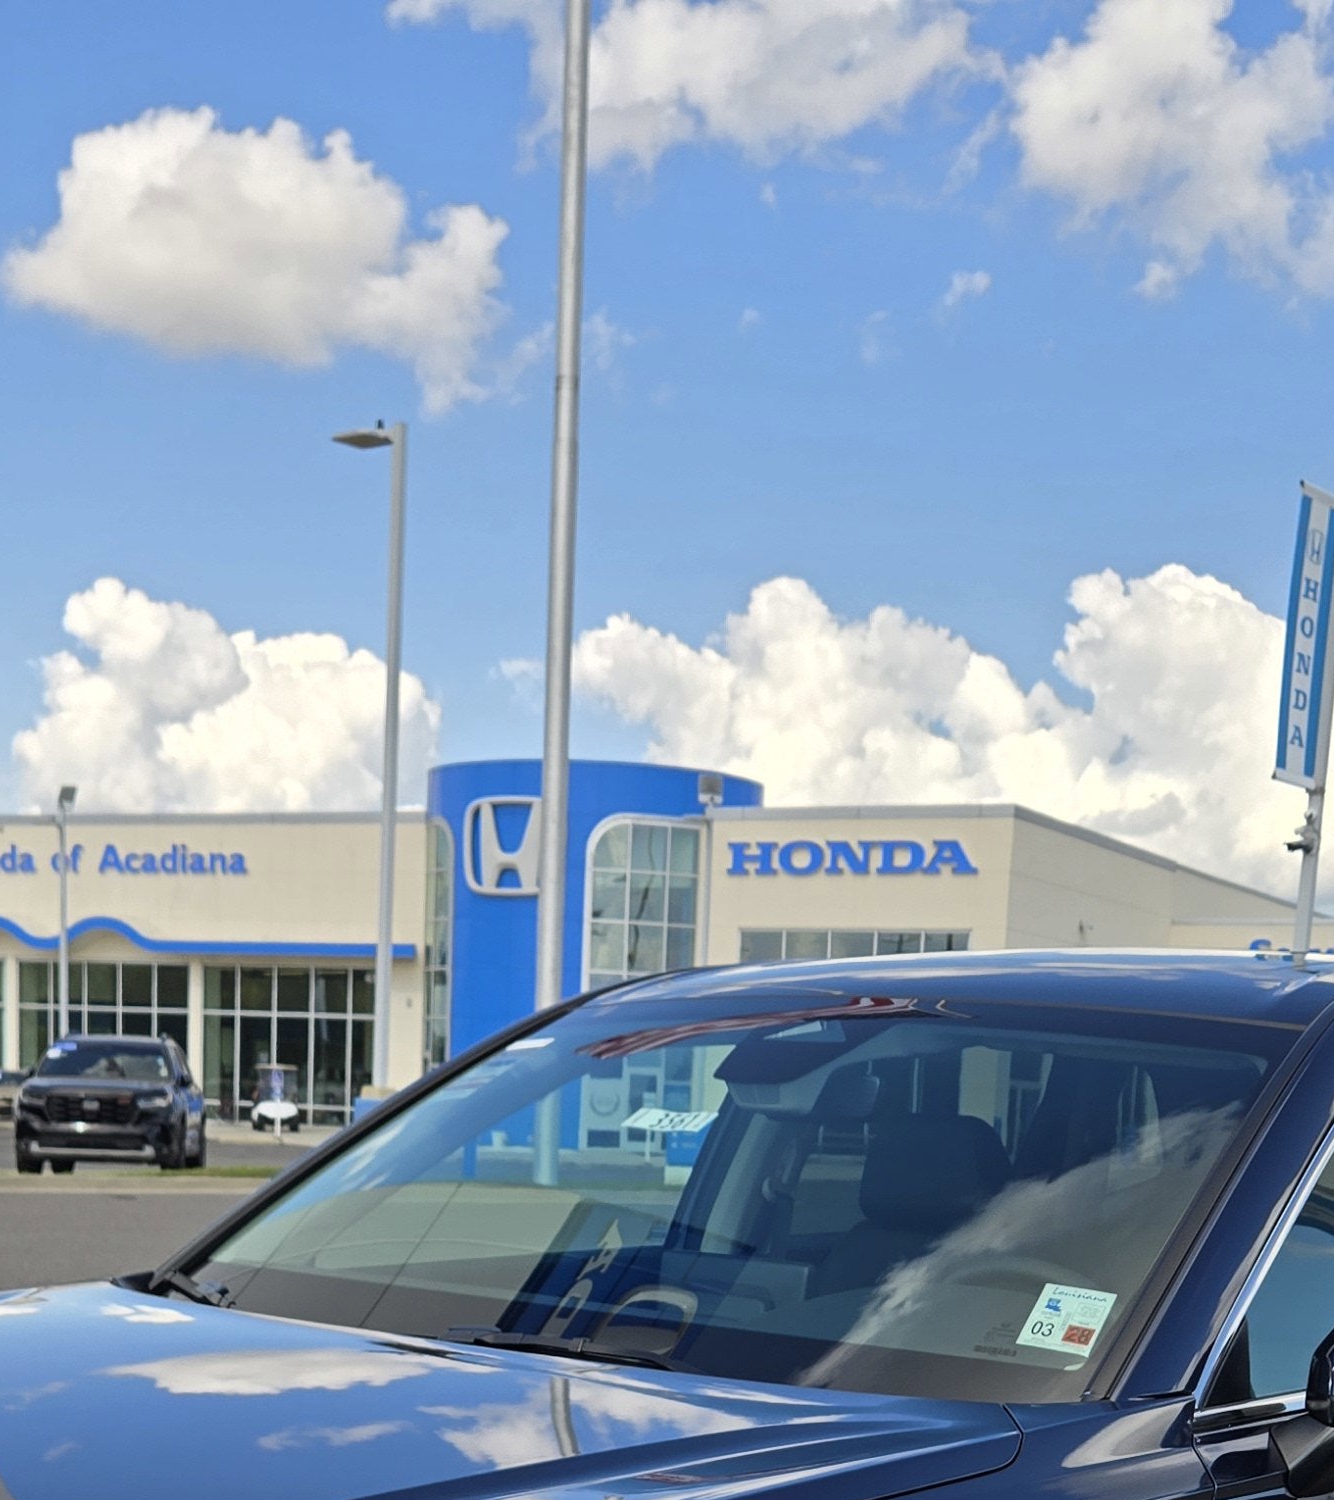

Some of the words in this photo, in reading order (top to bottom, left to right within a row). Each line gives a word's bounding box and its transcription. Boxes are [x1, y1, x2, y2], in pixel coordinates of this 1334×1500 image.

[1289, 577, 1320, 748] HONDA
[51, 843, 84, 873] of
[98, 843, 247, 875] Acadiana
[726, 839, 979, 876] HONDA
[1031, 1320, 1055, 1337] 03
